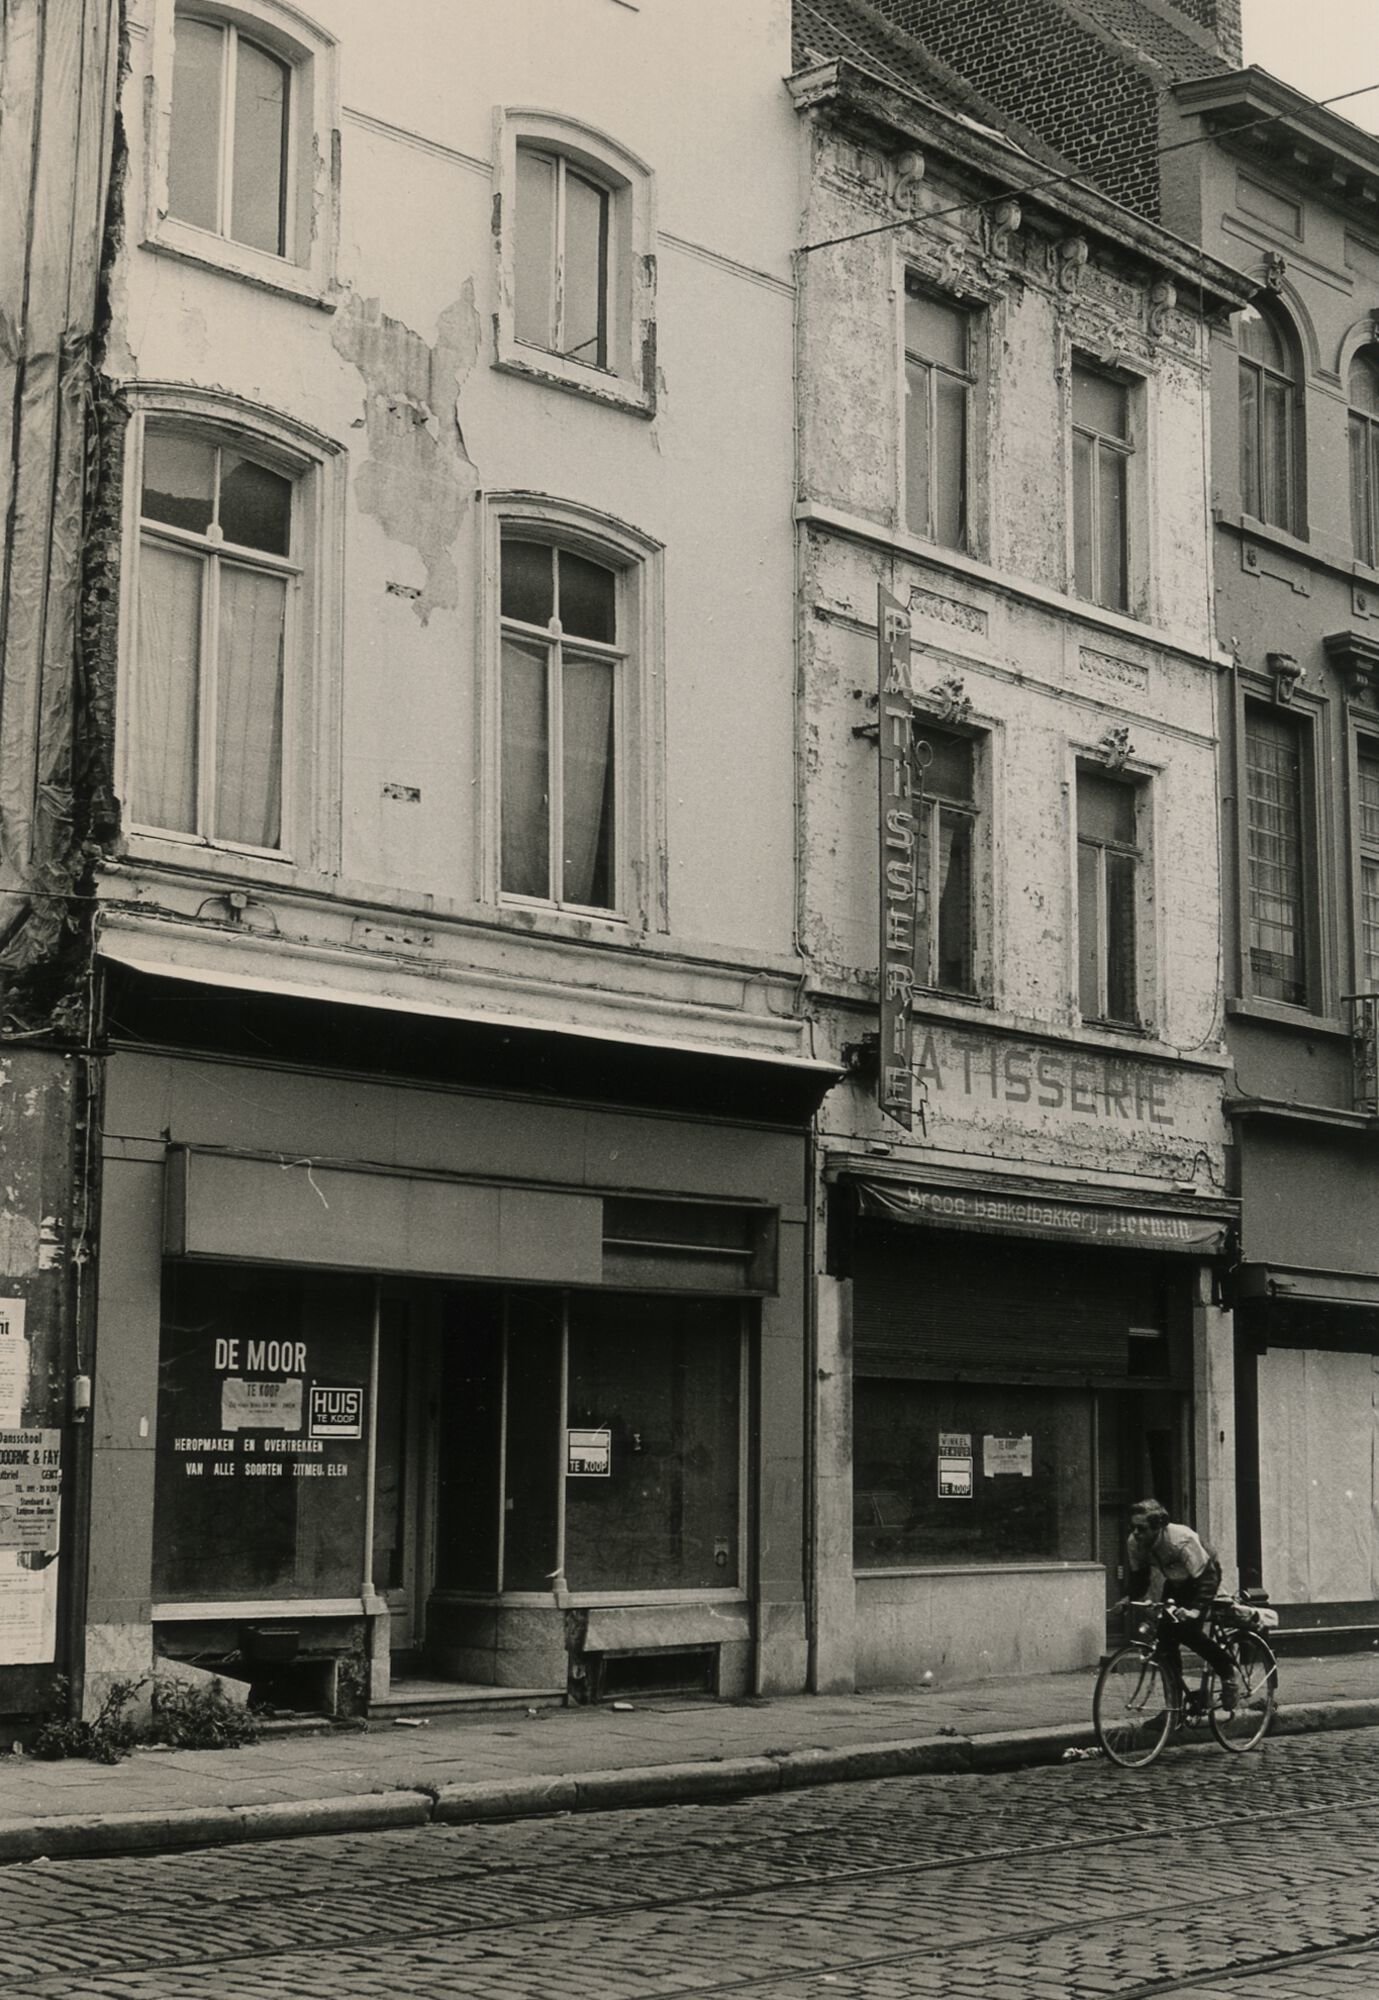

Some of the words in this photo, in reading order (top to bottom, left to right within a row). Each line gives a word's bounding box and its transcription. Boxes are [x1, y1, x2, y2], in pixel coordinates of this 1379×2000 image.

[883, 611, 916, 1105] PATISSERIE
[915, 1035, 1176, 1127] ATISSERIE
[214, 1338, 241, 1371] DE
[246, 1339, 308, 1374] MOOR
[247, 1383, 257, 1398] TE
[259, 1383, 281, 1398] KOOP
[313, 1390, 360, 1414] HUIS
[316, 1414, 328, 1423] TE
[330, 1414, 356, 1424] KOOP
[174, 1438, 235, 1452] HEROPMAKEN
[243, 1438, 256, 1452] EN
[264, 1439, 324, 1453] OVERTREKKEN
[33, 1449, 40, 1465] &
[43, 1449, 60, 1465] FAY
[186, 1462, 204, 1476] VAN
[213, 1463, 236, 1476] ALLE
[245, 1463, 283, 1477] SOORTEN
[292, 1463, 349, 1477] ZITMEUELEN
[570, 1460, 581, 1472] TE
[584, 1460, 608, 1473] KOOP
[941, 1483, 950, 1495] TE
[952, 1484, 970, 1495] KOOP
